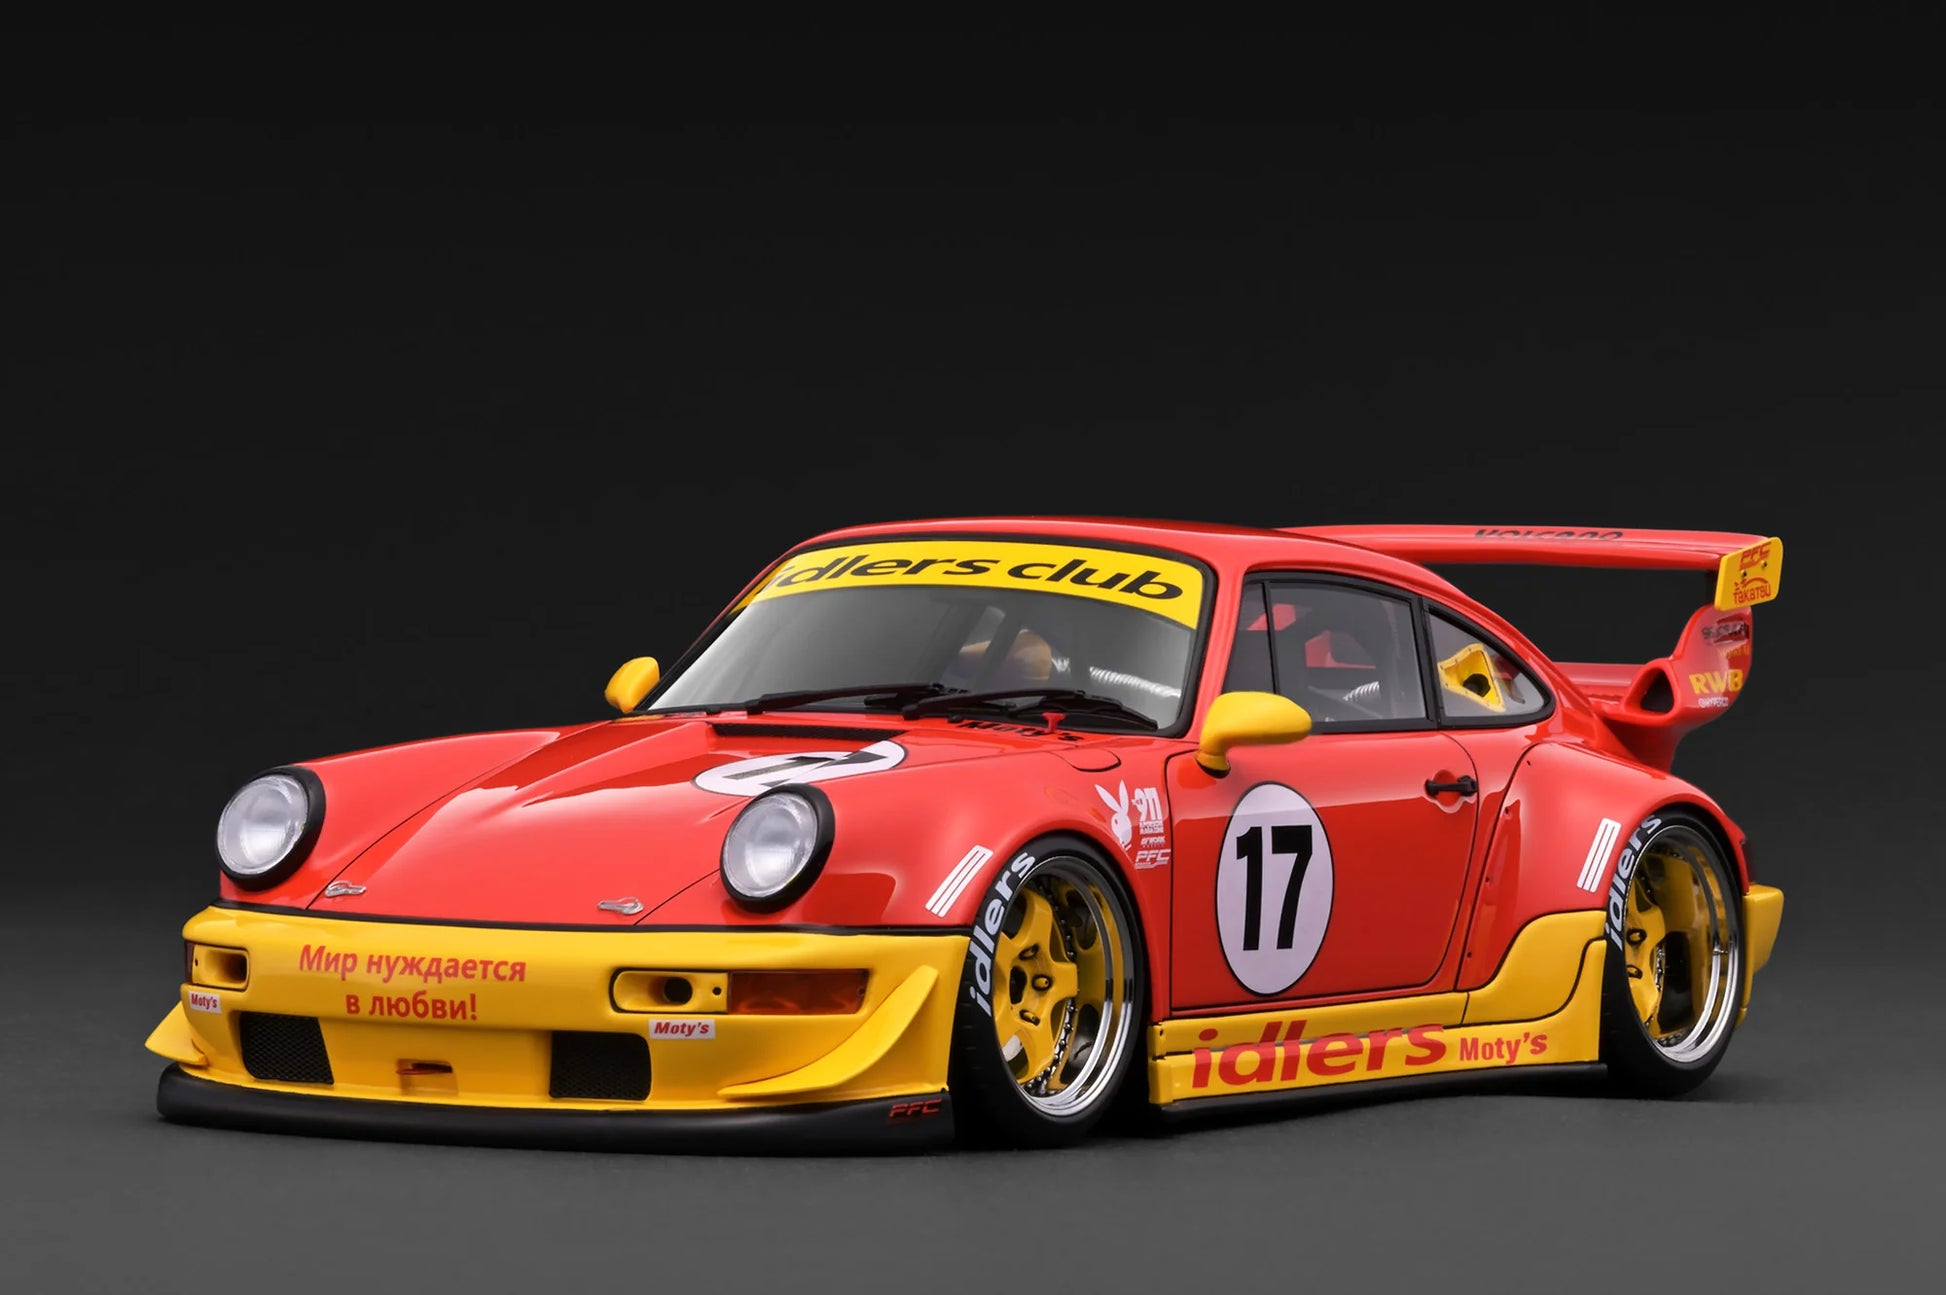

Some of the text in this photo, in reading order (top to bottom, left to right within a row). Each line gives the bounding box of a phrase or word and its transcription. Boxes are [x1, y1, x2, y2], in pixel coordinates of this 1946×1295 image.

[1008, 558, 1184, 601] club
[1689, 668, 1743, 695] RWB
[1135, 848, 1171, 866] PFC
[1236, 824, 1313, 951] 17
[1604, 814, 1662, 951] idlers
[969, 852, 1036, 1018] idlers
[299, 944, 527, 984] Мир нуждается
[191, 993, 218, 1010] Moty's
[345, 990, 478, 1021] в любви!
[654, 1021, 710, 1037] Moty's
[1191, 1019, 1548, 1090] idlers Moty's
[889, 1098, 942, 1117] PFC
